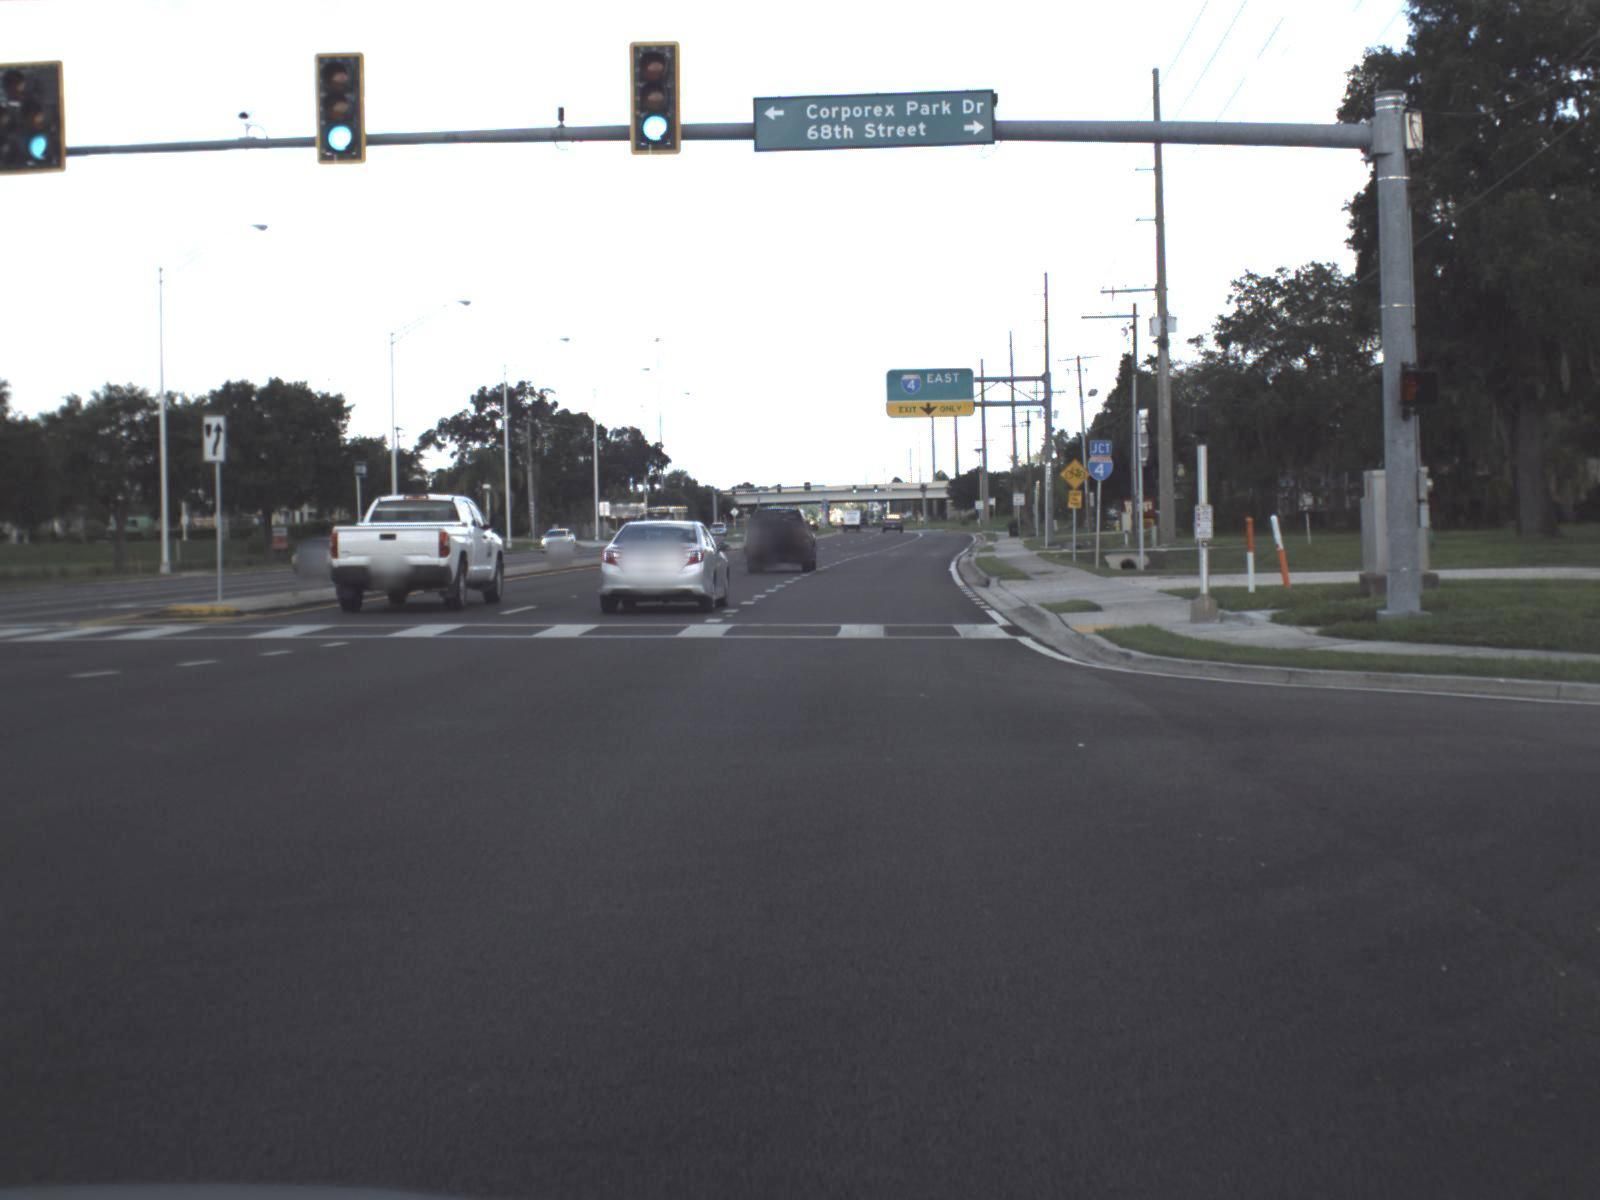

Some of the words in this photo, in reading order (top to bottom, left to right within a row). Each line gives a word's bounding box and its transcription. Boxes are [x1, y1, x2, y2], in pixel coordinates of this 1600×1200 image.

[806, 102, 895, 121] Corporex
[906, 100, 951, 116] Park
[962, 99, 985, 114] Dr
[806, 124, 854, 140] 68th
[864, 122, 926, 138] Street
[926, 372, 960, 384] EAST
[906, 379, 916, 391] 4
[1091, 443, 1110, 454] JCT
[1094, 464, 1105, 476] 4
